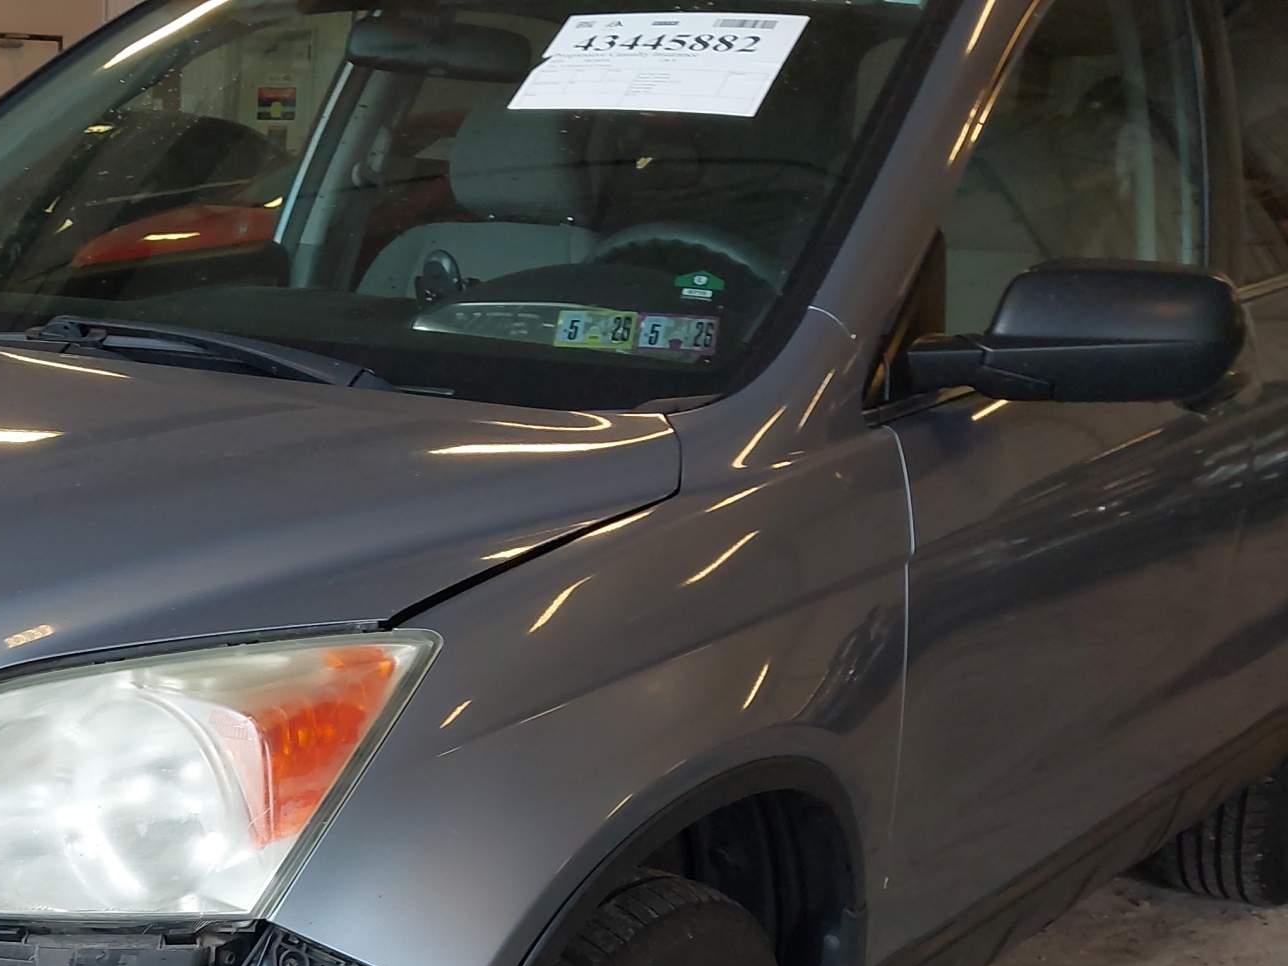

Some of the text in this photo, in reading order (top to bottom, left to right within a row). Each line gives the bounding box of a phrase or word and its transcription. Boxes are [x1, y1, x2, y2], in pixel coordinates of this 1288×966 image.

[573, 33, 761, 53] 43445882
[567, 319, 581, 341] 5
[648, 323, 662, 346] 5
